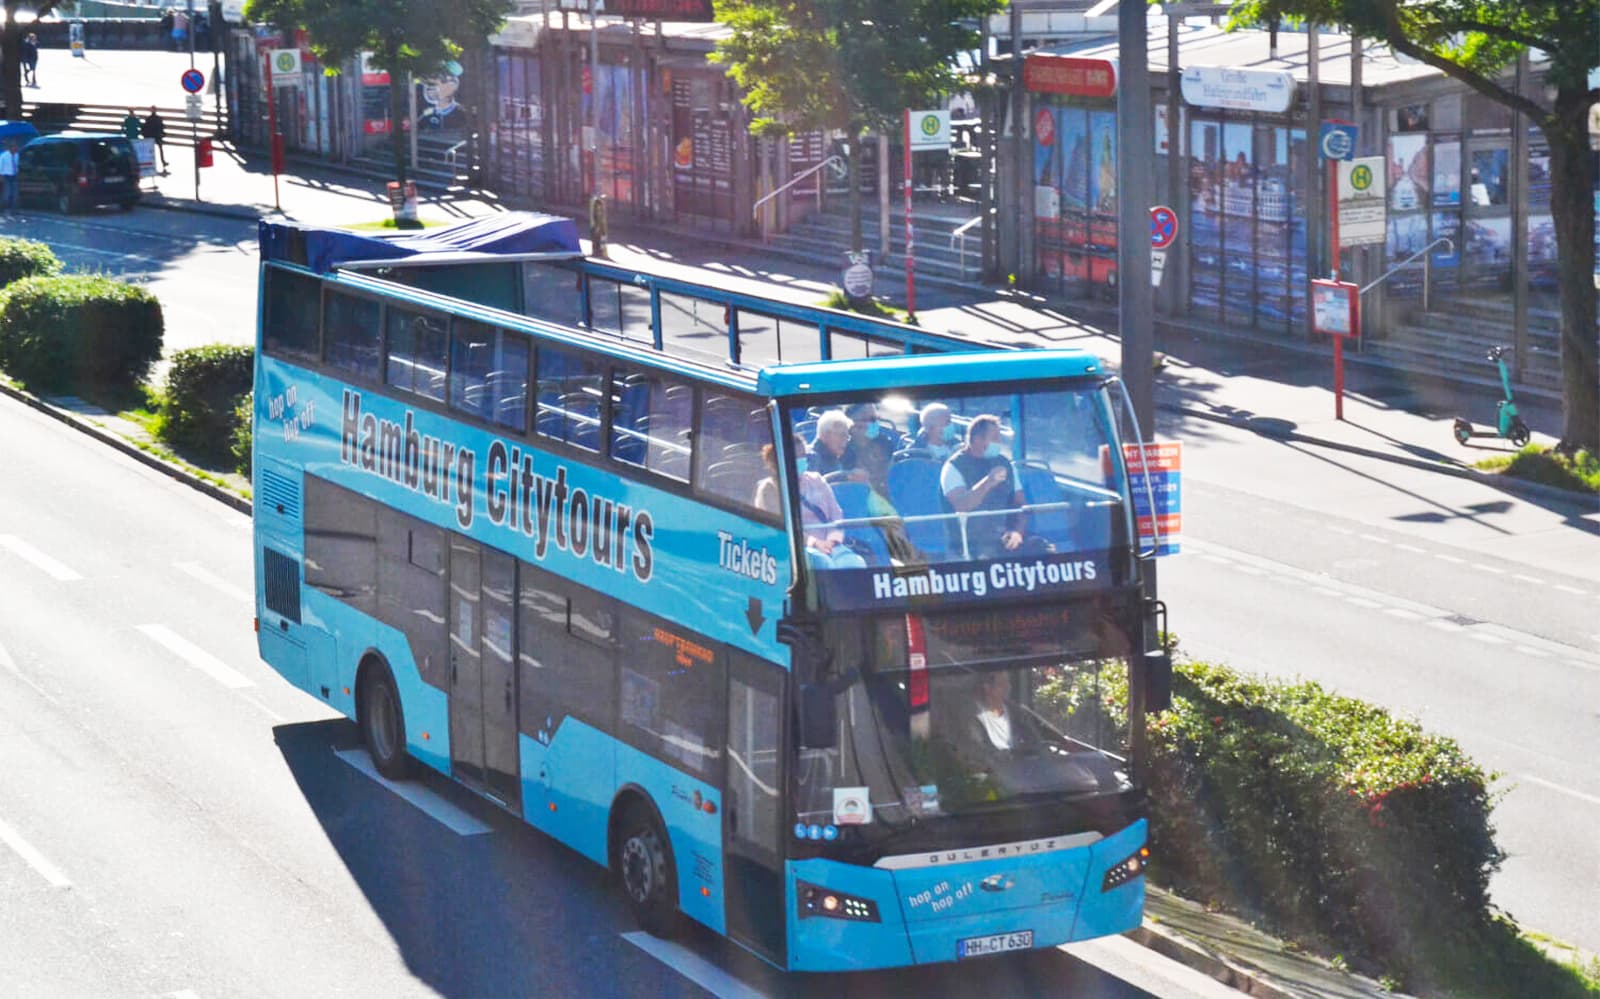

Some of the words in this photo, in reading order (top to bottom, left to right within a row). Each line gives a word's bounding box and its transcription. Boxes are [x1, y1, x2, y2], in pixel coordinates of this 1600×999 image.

[341, 388, 475, 528] Hamburg
[486, 439, 655, 583] Citytours
[718, 530, 777, 585] Tickets
[873, 569, 987, 599] Hamburg
[990, 560, 1097, 591] Citytours
[908, 890, 932, 908] hop
[933, 881, 950, 895] on
[931, 894, 954, 913] hop
[955, 881, 974, 899] off
[1008, 933, 1031, 949] 630
